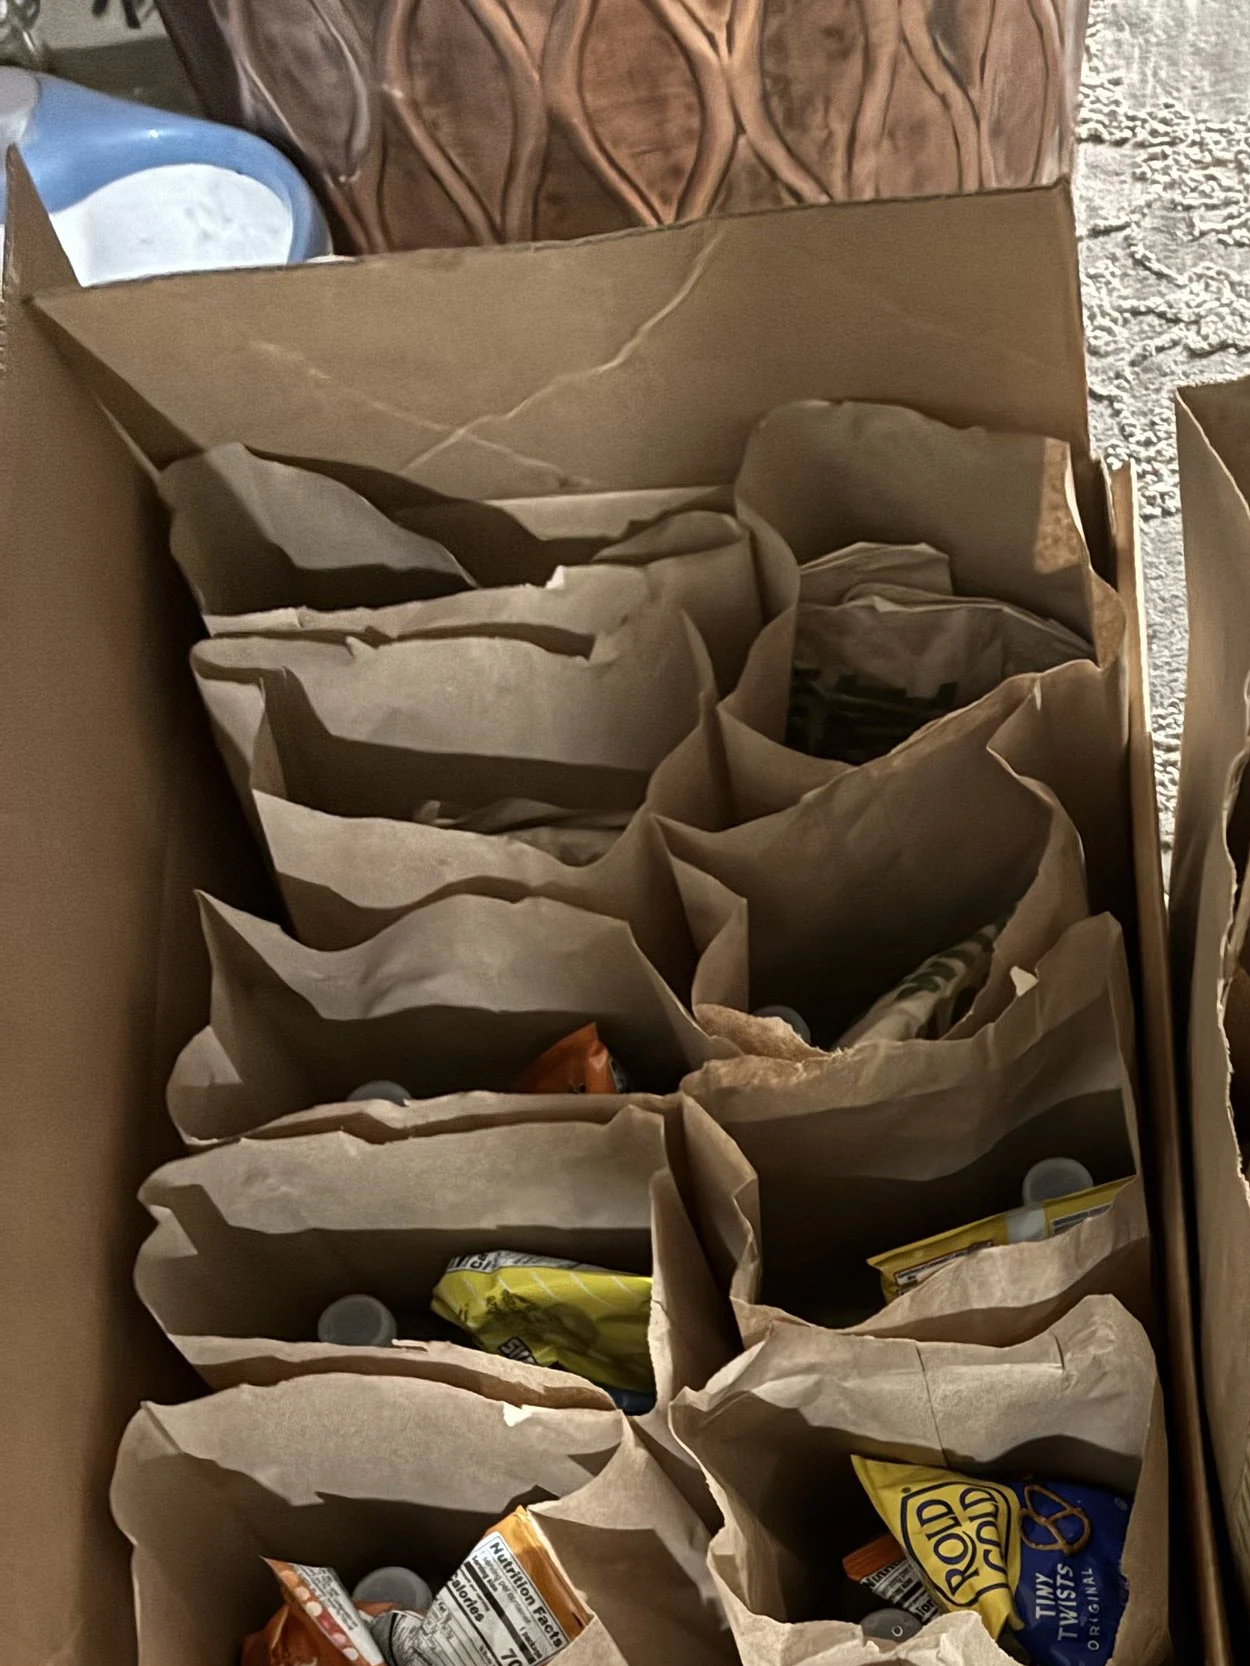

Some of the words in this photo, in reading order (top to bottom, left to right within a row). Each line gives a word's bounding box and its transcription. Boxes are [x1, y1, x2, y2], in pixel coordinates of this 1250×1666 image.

[916, 1498, 980, 1597] ROLD
[489, 1541, 537, 1607] Nutrition
[532, 1606, 563, 1649] Facts
[1035, 1572, 1056, 1620] TINY
[1056, 1562, 1078, 1641] TWISTS
[1081, 1567, 1100, 1651] ORIGINAL
